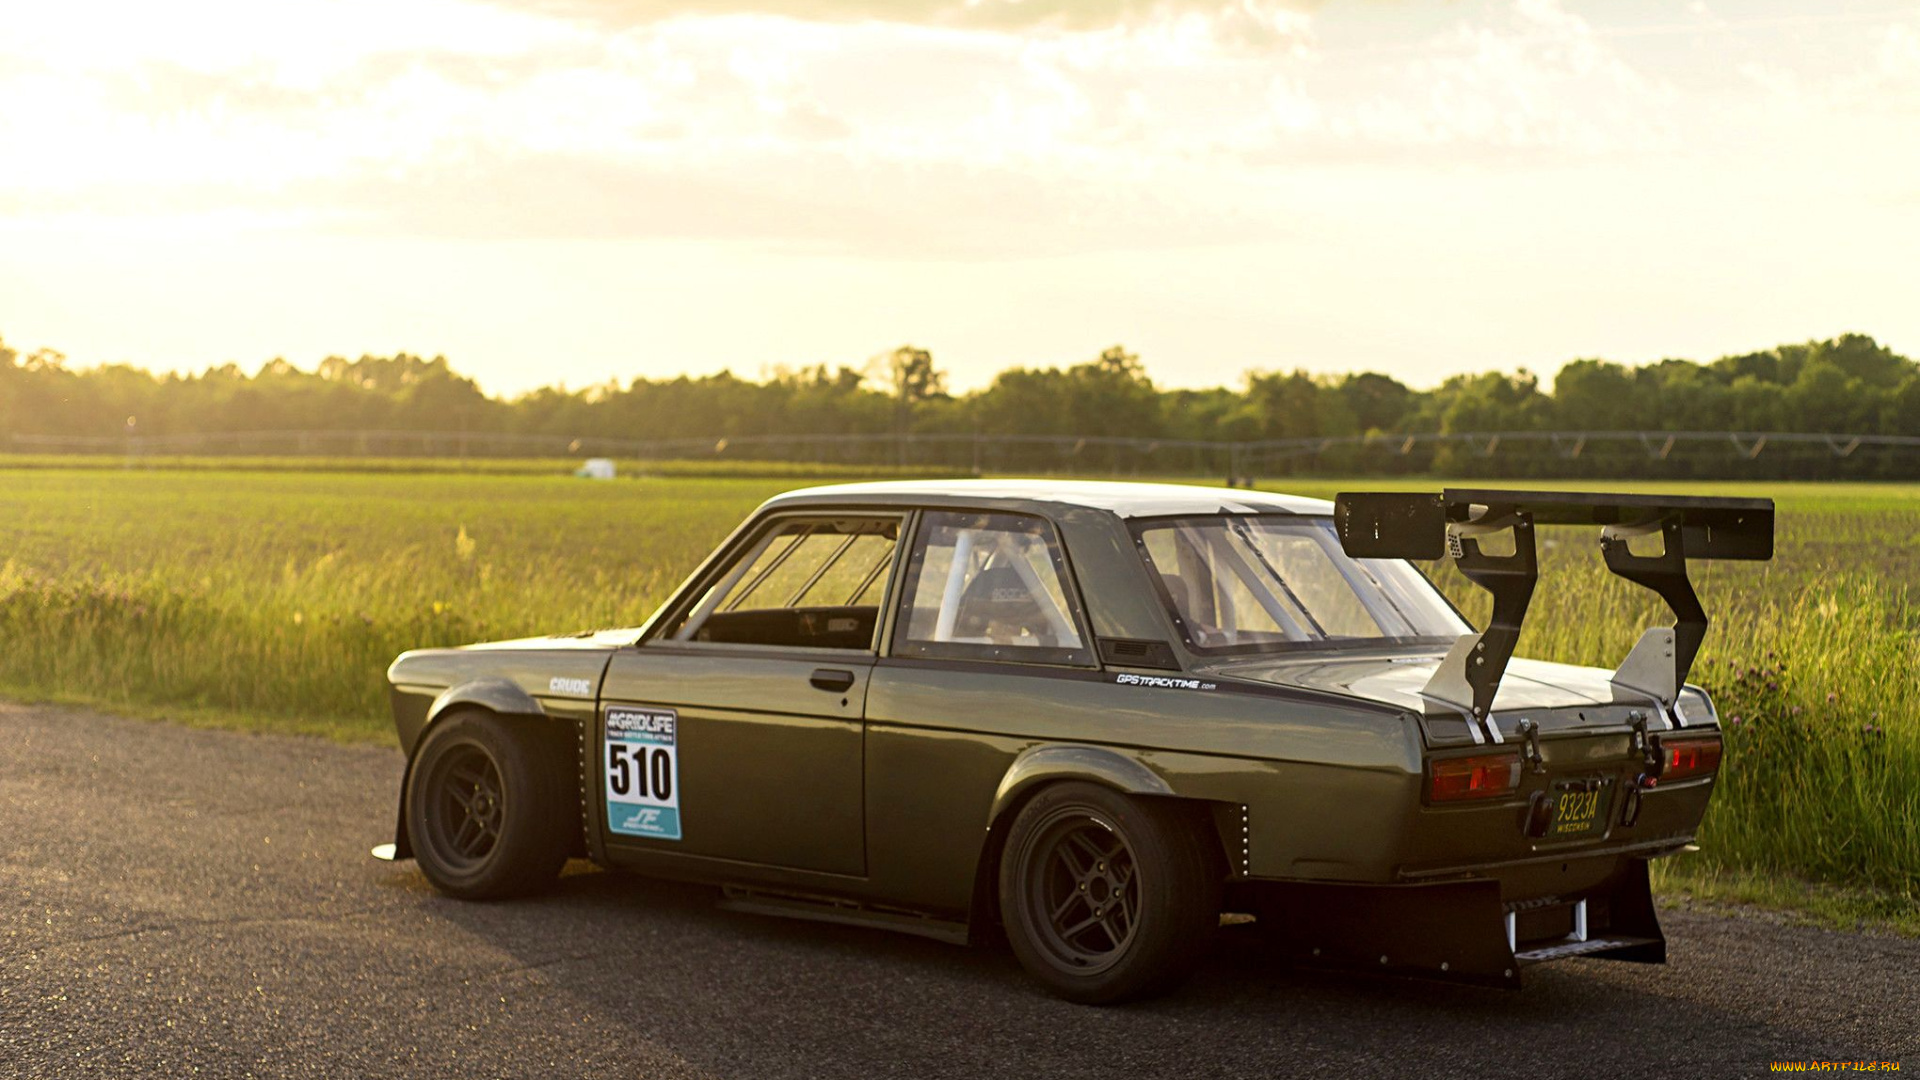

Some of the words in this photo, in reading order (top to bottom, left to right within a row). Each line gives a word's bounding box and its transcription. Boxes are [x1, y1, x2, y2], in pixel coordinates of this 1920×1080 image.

[607, 712, 673, 733] #GRIDLIFE
[610, 744, 671, 801] 510
[1558, 790, 1598, 821] 9323A
